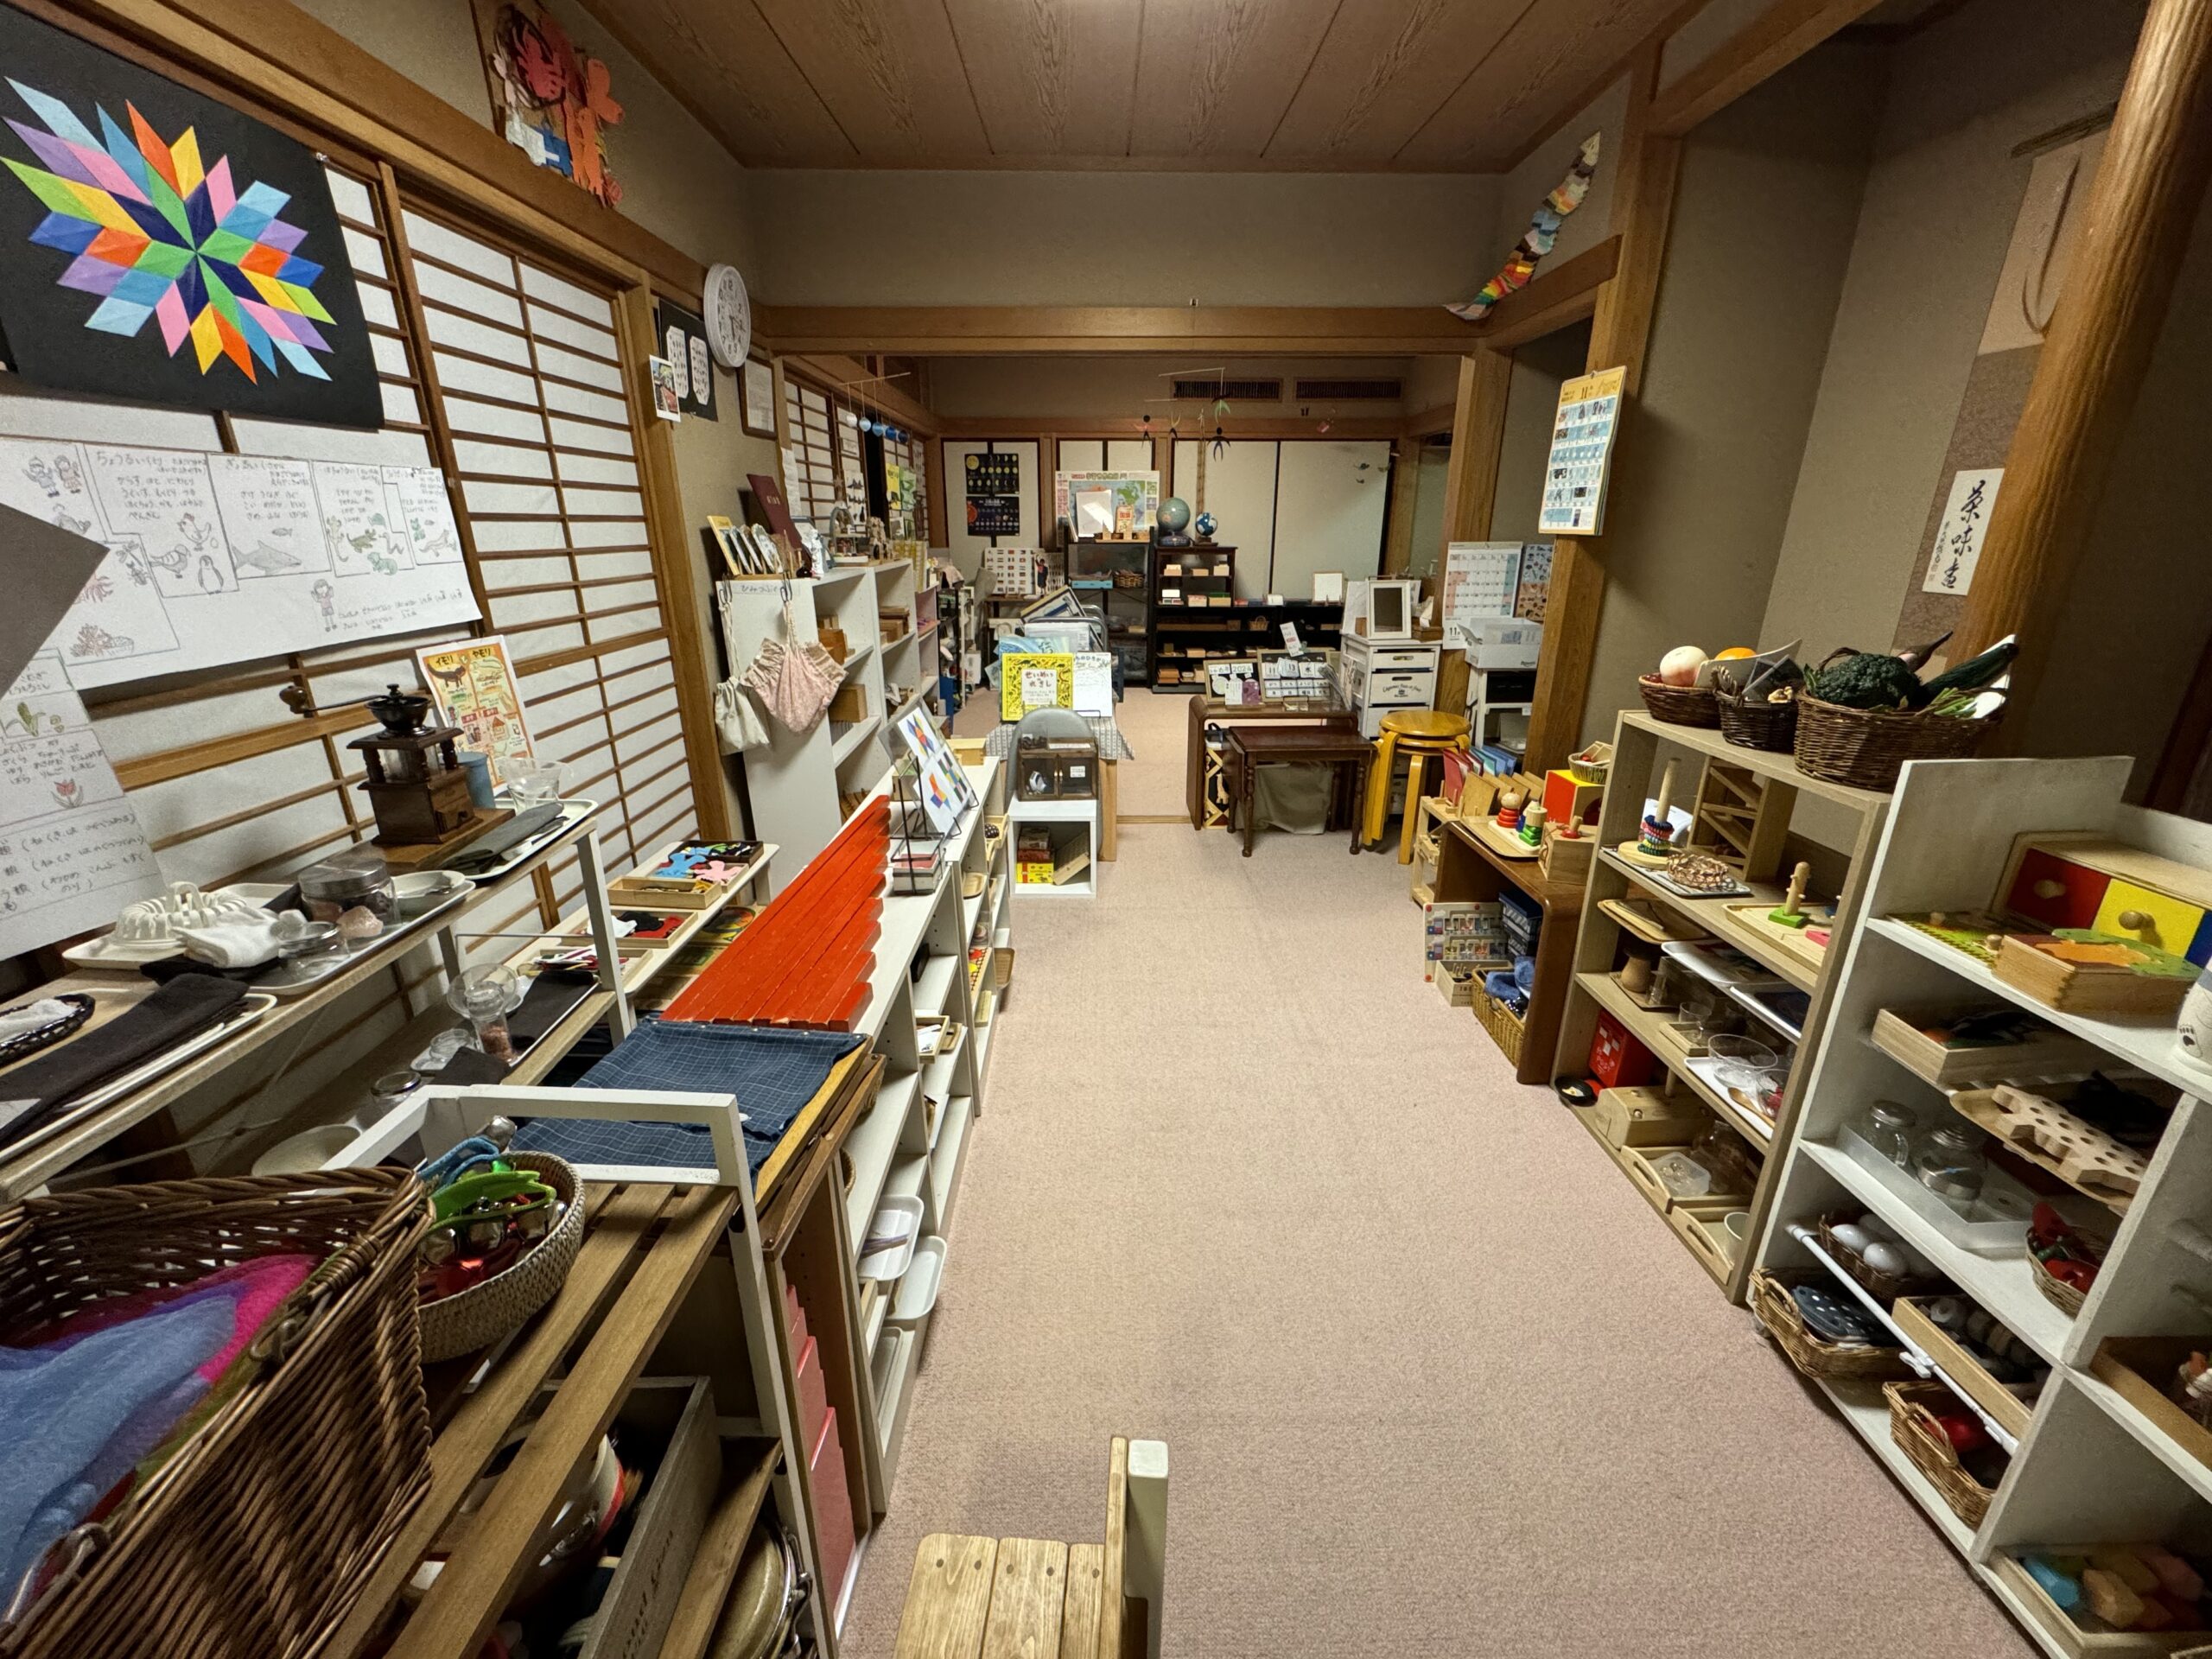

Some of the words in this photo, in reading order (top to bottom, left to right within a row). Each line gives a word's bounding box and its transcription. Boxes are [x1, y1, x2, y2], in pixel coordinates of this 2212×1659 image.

[435, 654, 454, 666] イモリ
[472, 647, 491, 658] ヤモリ
